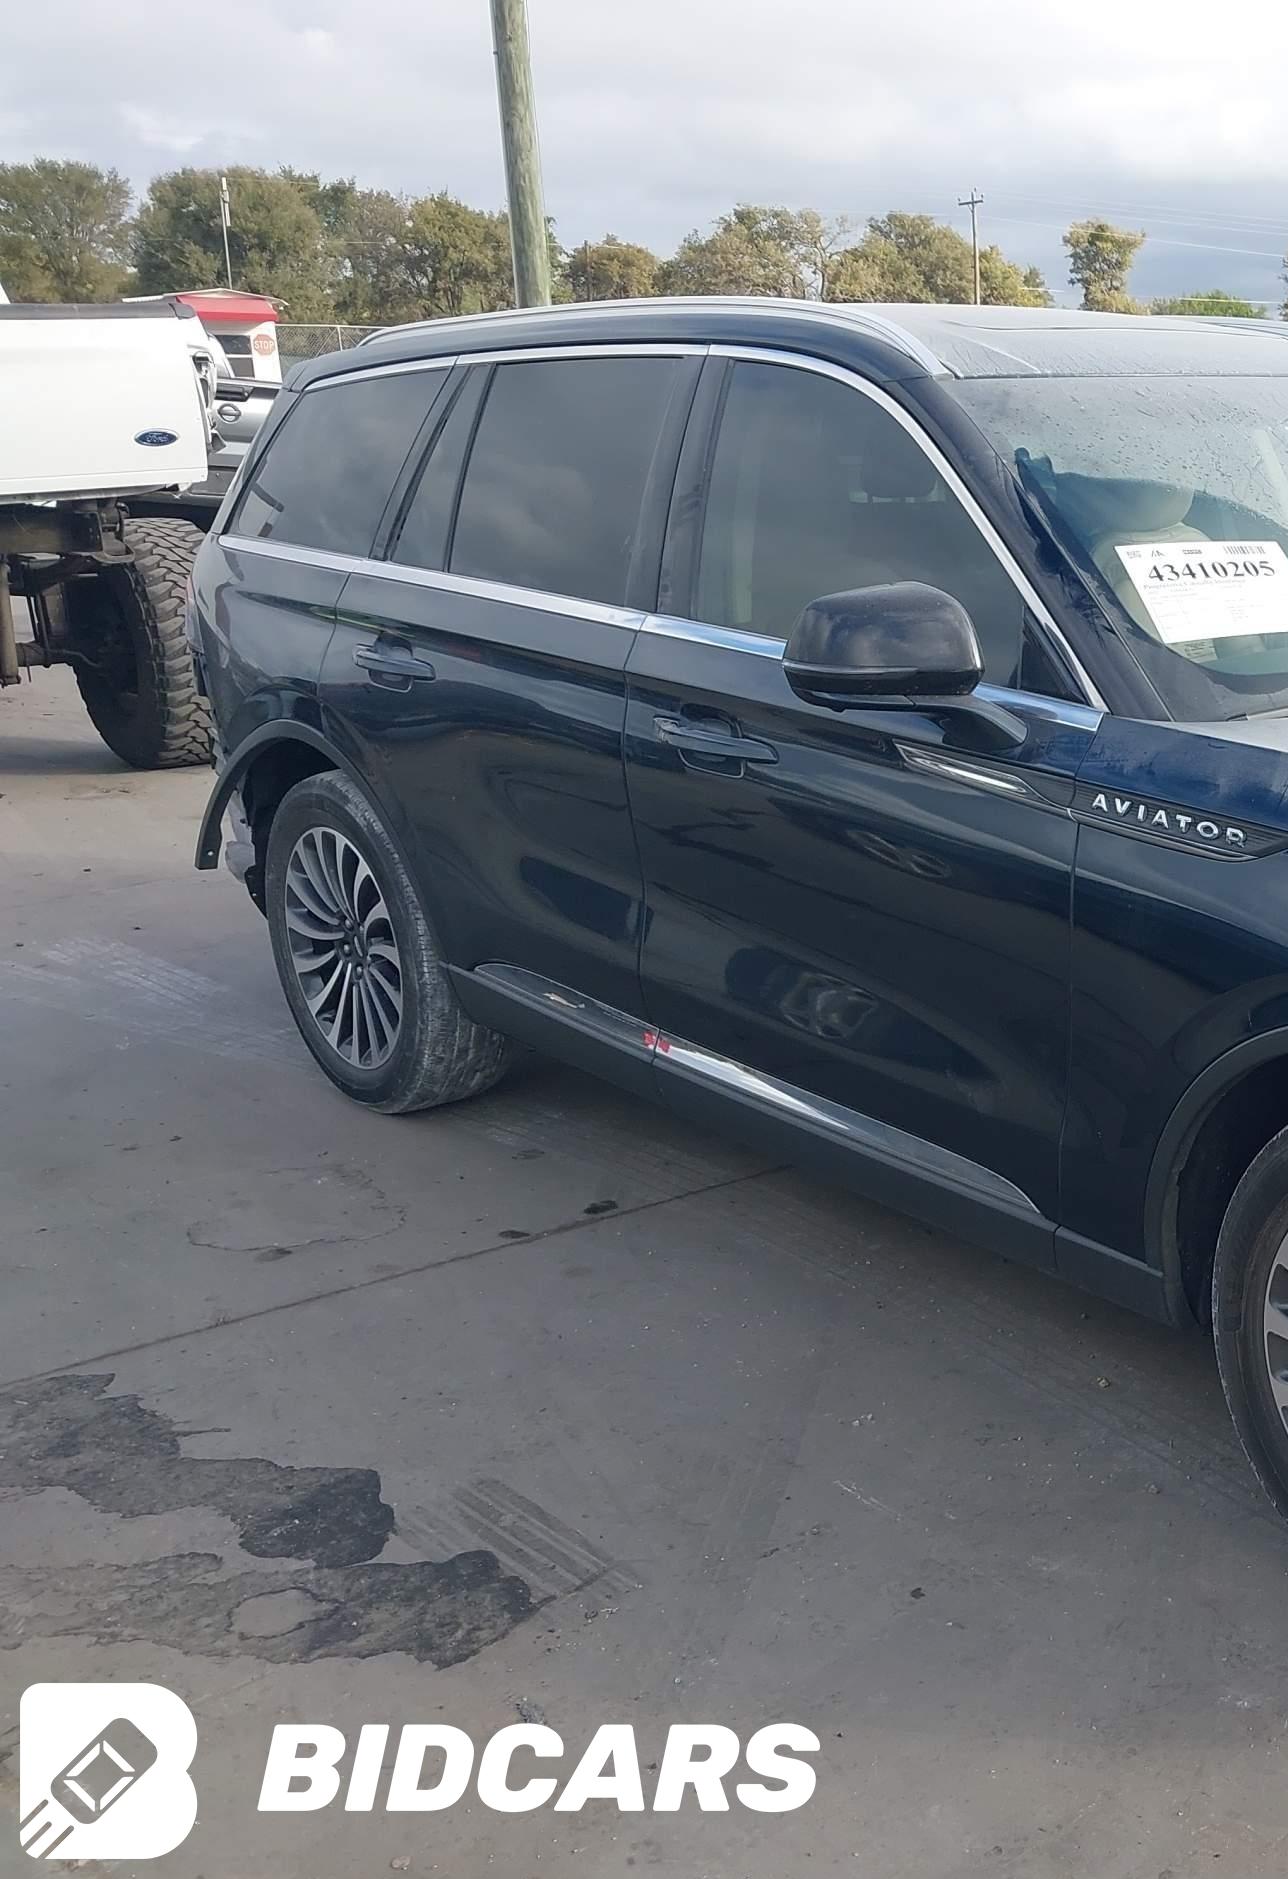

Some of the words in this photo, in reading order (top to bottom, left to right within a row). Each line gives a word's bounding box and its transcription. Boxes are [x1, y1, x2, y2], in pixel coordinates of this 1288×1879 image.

[254, 340, 274, 352] STOP
[1148, 560, 1276, 581] 43410205
[1092, 793, 1245, 848] AVIATOR
